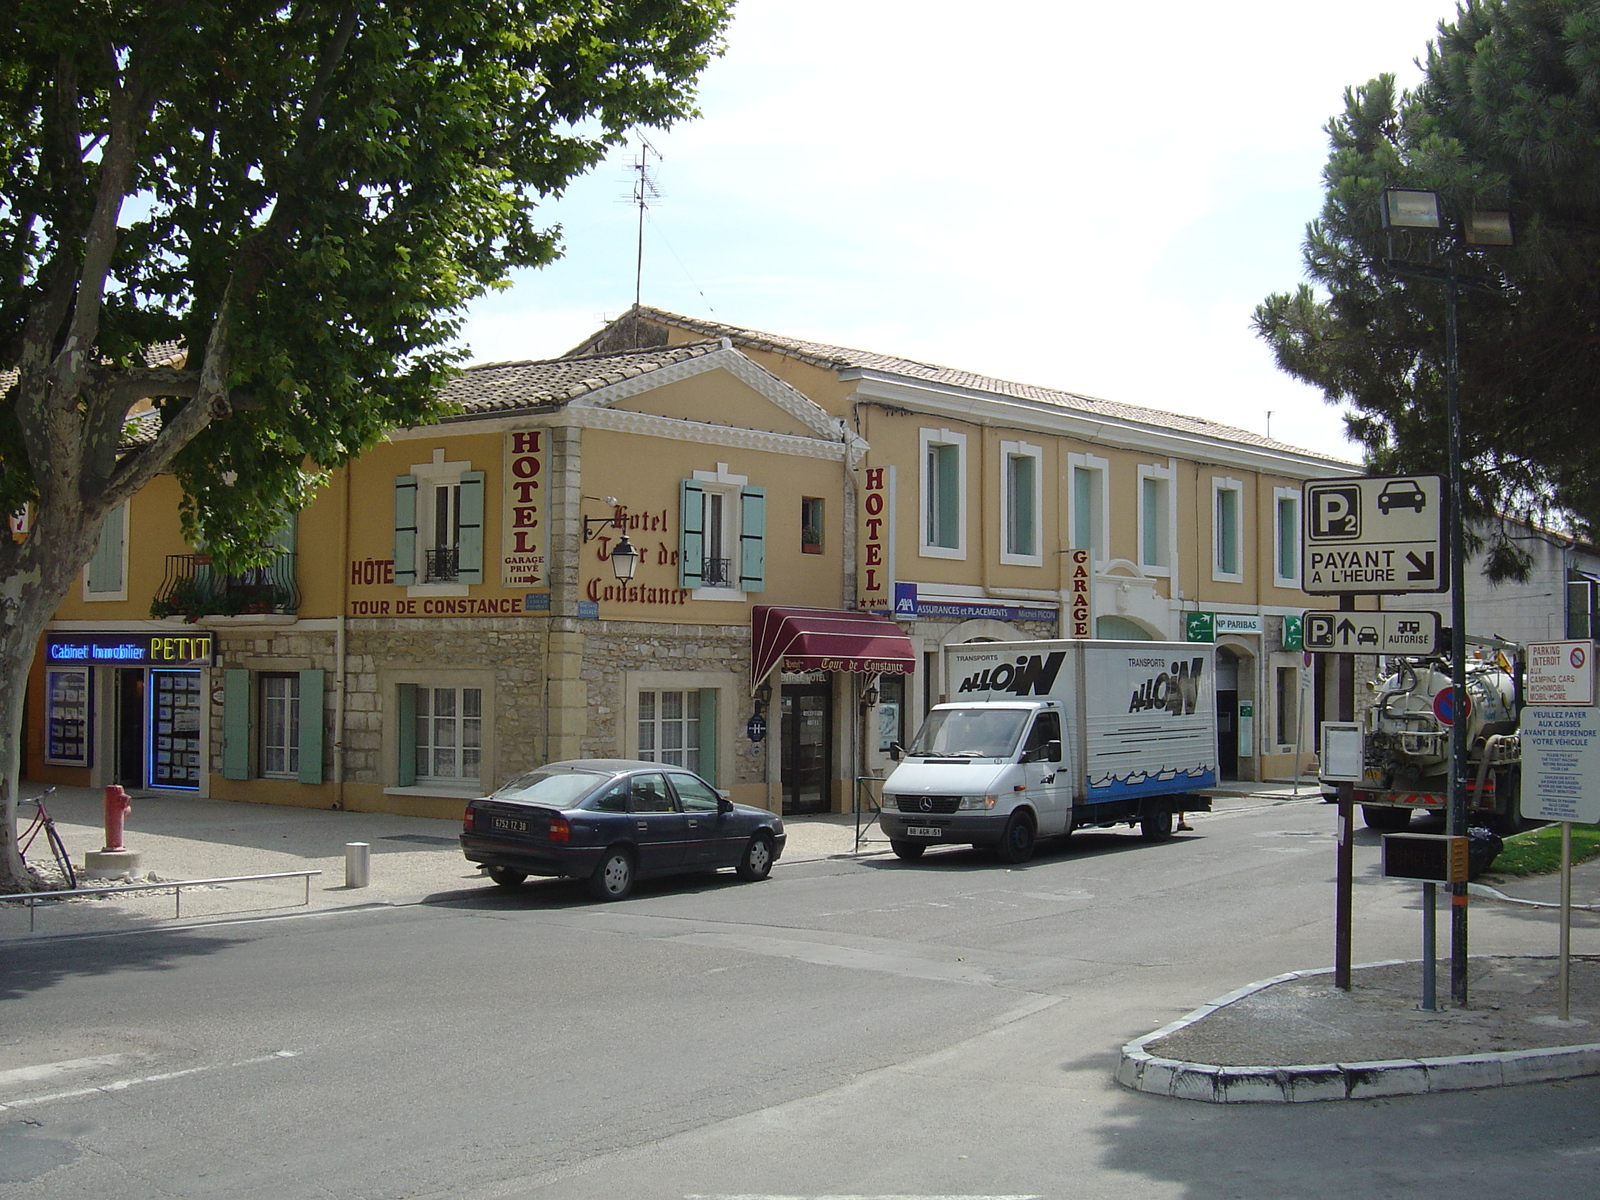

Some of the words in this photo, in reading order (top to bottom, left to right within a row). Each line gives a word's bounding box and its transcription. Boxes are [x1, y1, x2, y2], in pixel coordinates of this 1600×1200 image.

[512, 432, 541, 553] HOTEL
[614, 504, 668, 532] Hotel
[866, 468, 884, 590] HOTEL
[598, 536, 648, 564] Tr
[658, 542, 679, 566] de
[505, 556, 544, 564] GARAGE
[510, 562, 539, 572] PRIVÉ
[1312, 550, 1395, 570] PAYANT
[352, 558, 394, 584] HÔTE
[1312, 572, 1322, 583] A
[1332, 569, 1395, 583] L'HEURE
[586, 577, 688, 605] Constance
[1073, 550, 1088, 635] GARAGE
[351, 601, 390, 614] TOUR
[396, 600, 416, 614] DE
[424, 599, 522, 614] CONSTANCE
[896, 599, 914, 611] AXA
[917, 605, 959, 615] ASSURANCES
[968, 607, 1008, 616] PLACEMENTS
[1388, 634, 1429, 644] AUTORISÉ
[51, 644, 89, 659] Cabinet
[92, 644, 146, 660] Immobilier
[151, 638, 210, 660] PETIT
[1533, 646, 1560, 655] PARKING
[821, 658, 843, 669] Tour
[849, 660, 858, 670] de
[864, 660, 904, 672] Constance
[1128, 658, 1165, 667] TRANSPORTS
[1533, 657, 1560, 666] INTERDIT
